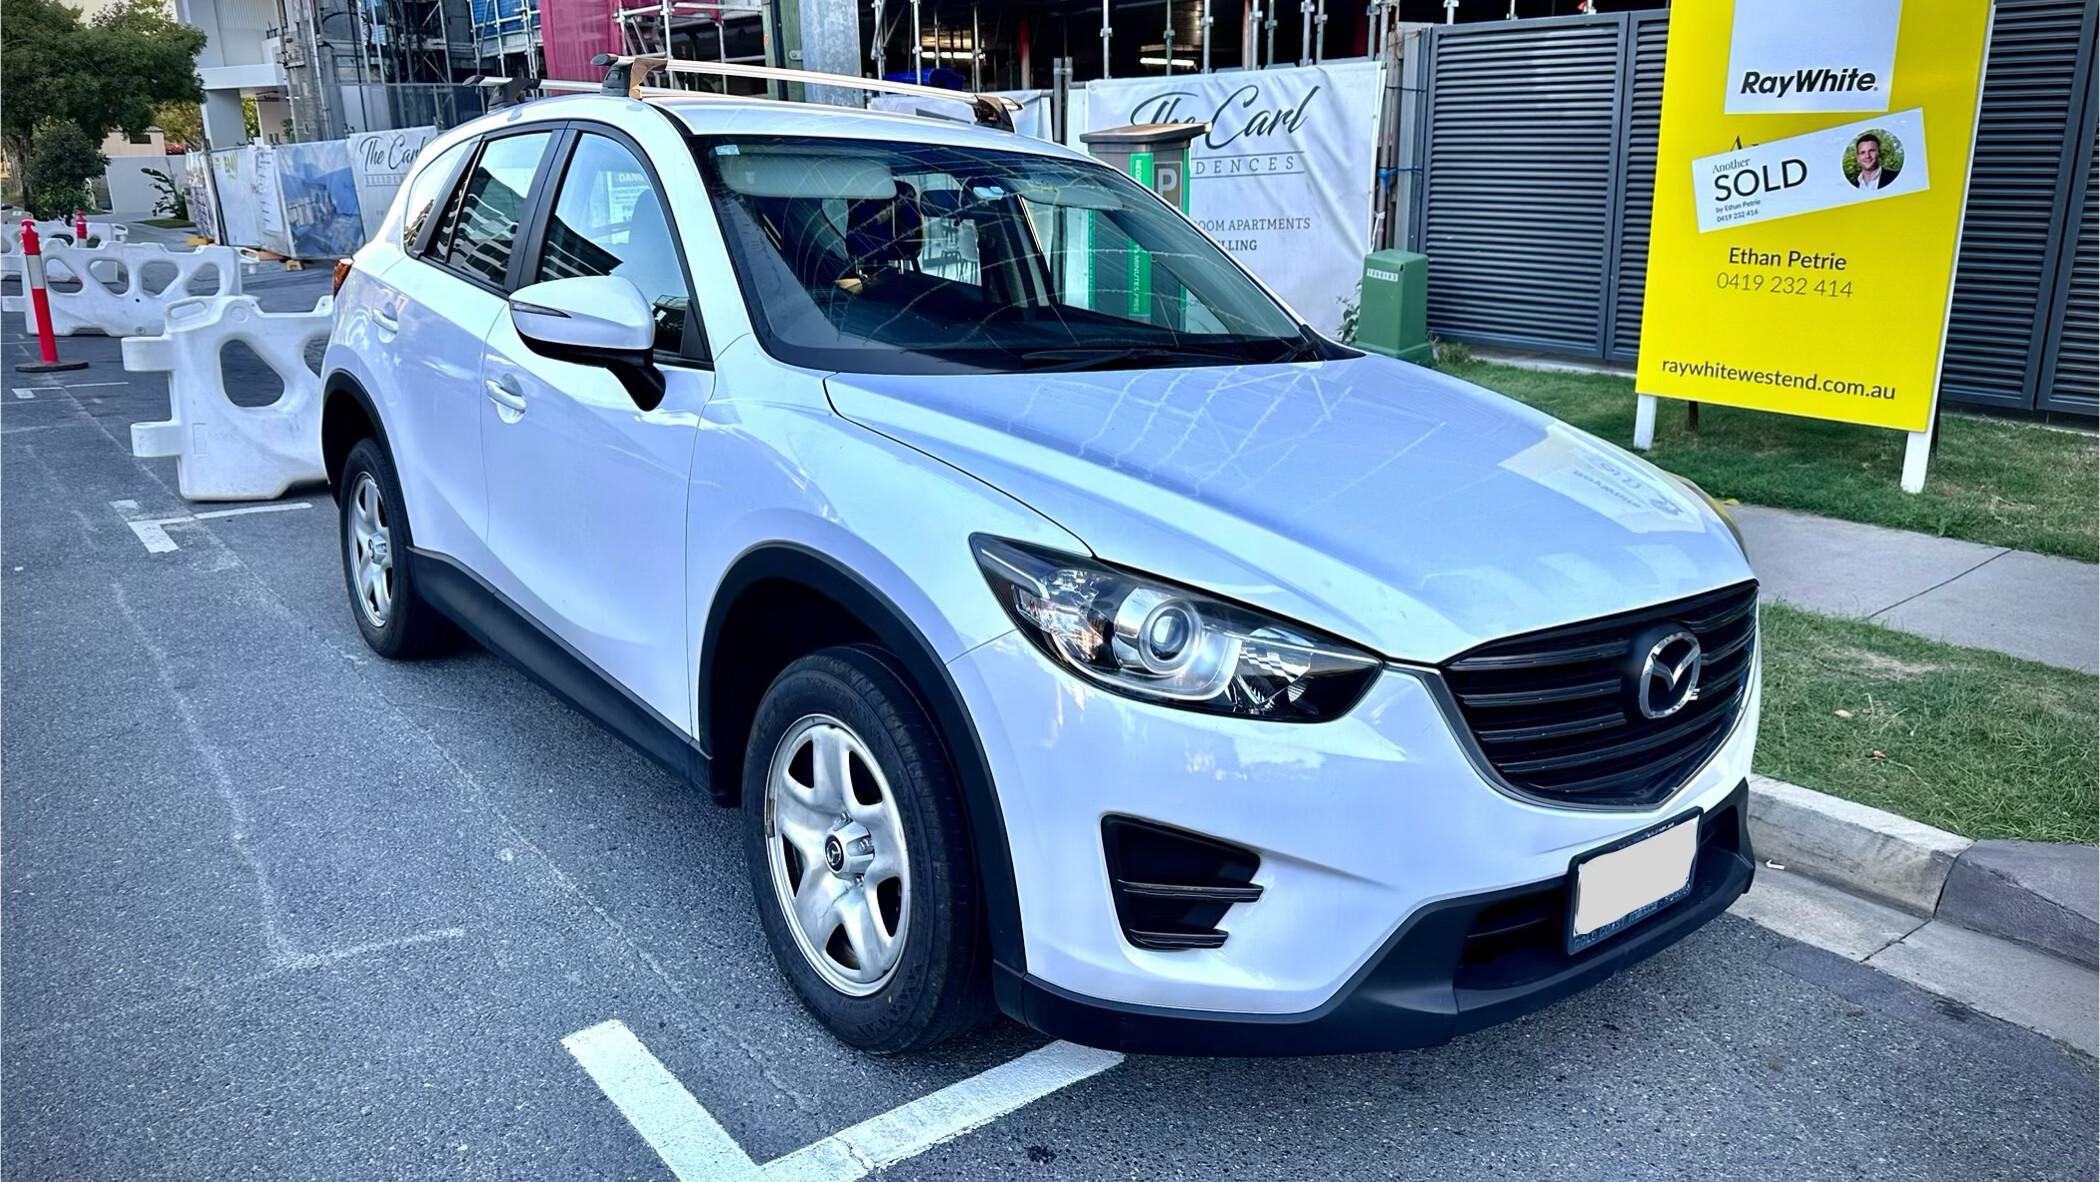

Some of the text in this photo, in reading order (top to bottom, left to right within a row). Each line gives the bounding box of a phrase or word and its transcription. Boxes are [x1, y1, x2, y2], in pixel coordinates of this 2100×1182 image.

[1205, 84, 1320, 149] Carl
[1195, 156, 1294, 175] DENCES
[1712, 158, 1751, 174] Another
[1157, 168, 1178, 197] P
[1714, 158, 1808, 202] SOLD
[1228, 217, 1311, 232] APARTMENTS
[1221, 239, 1257, 251] LLING
[1729, 247, 1847, 271] Ethan Petrie
[1716, 272, 1853, 298] 0419 232 414
[1662, 359, 1896, 400] raywhitewestend.com.au
